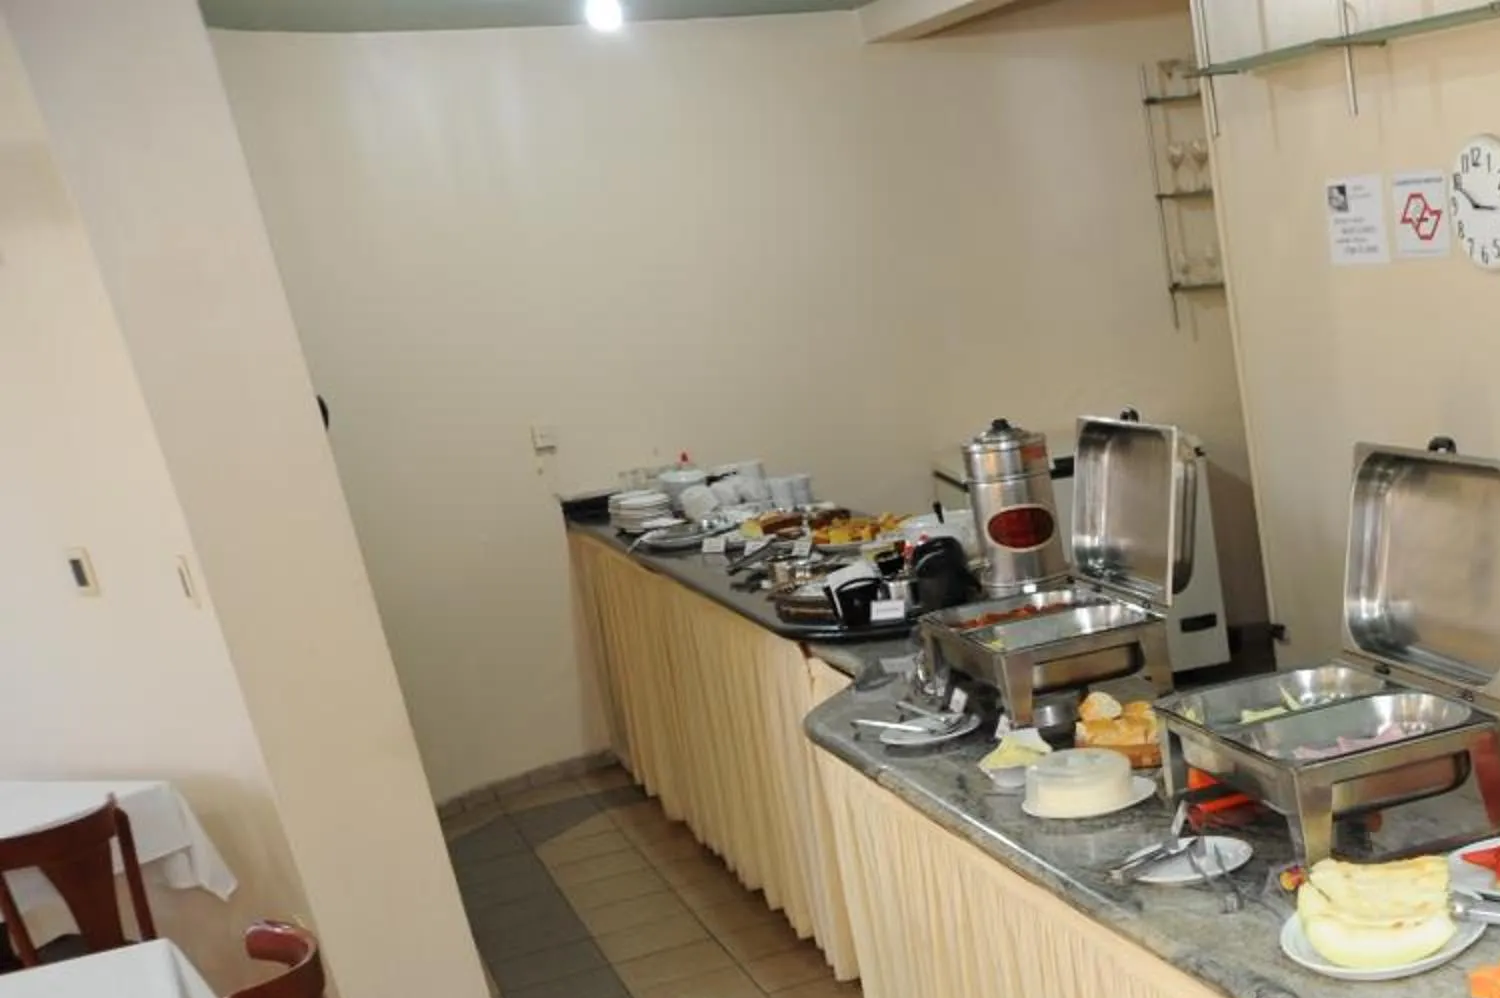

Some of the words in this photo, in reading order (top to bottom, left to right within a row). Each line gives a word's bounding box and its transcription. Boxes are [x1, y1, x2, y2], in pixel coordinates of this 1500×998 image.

[1461, 153, 1470, 174] 11
[1470, 147, 1481, 167] 12
[1486, 152, 1492, 173] 1
[1453, 172, 1463, 191] 10
[1458, 220, 1465, 239] 8
[1467, 238, 1475, 258] 7
[1481, 245, 1489, 265] 6
